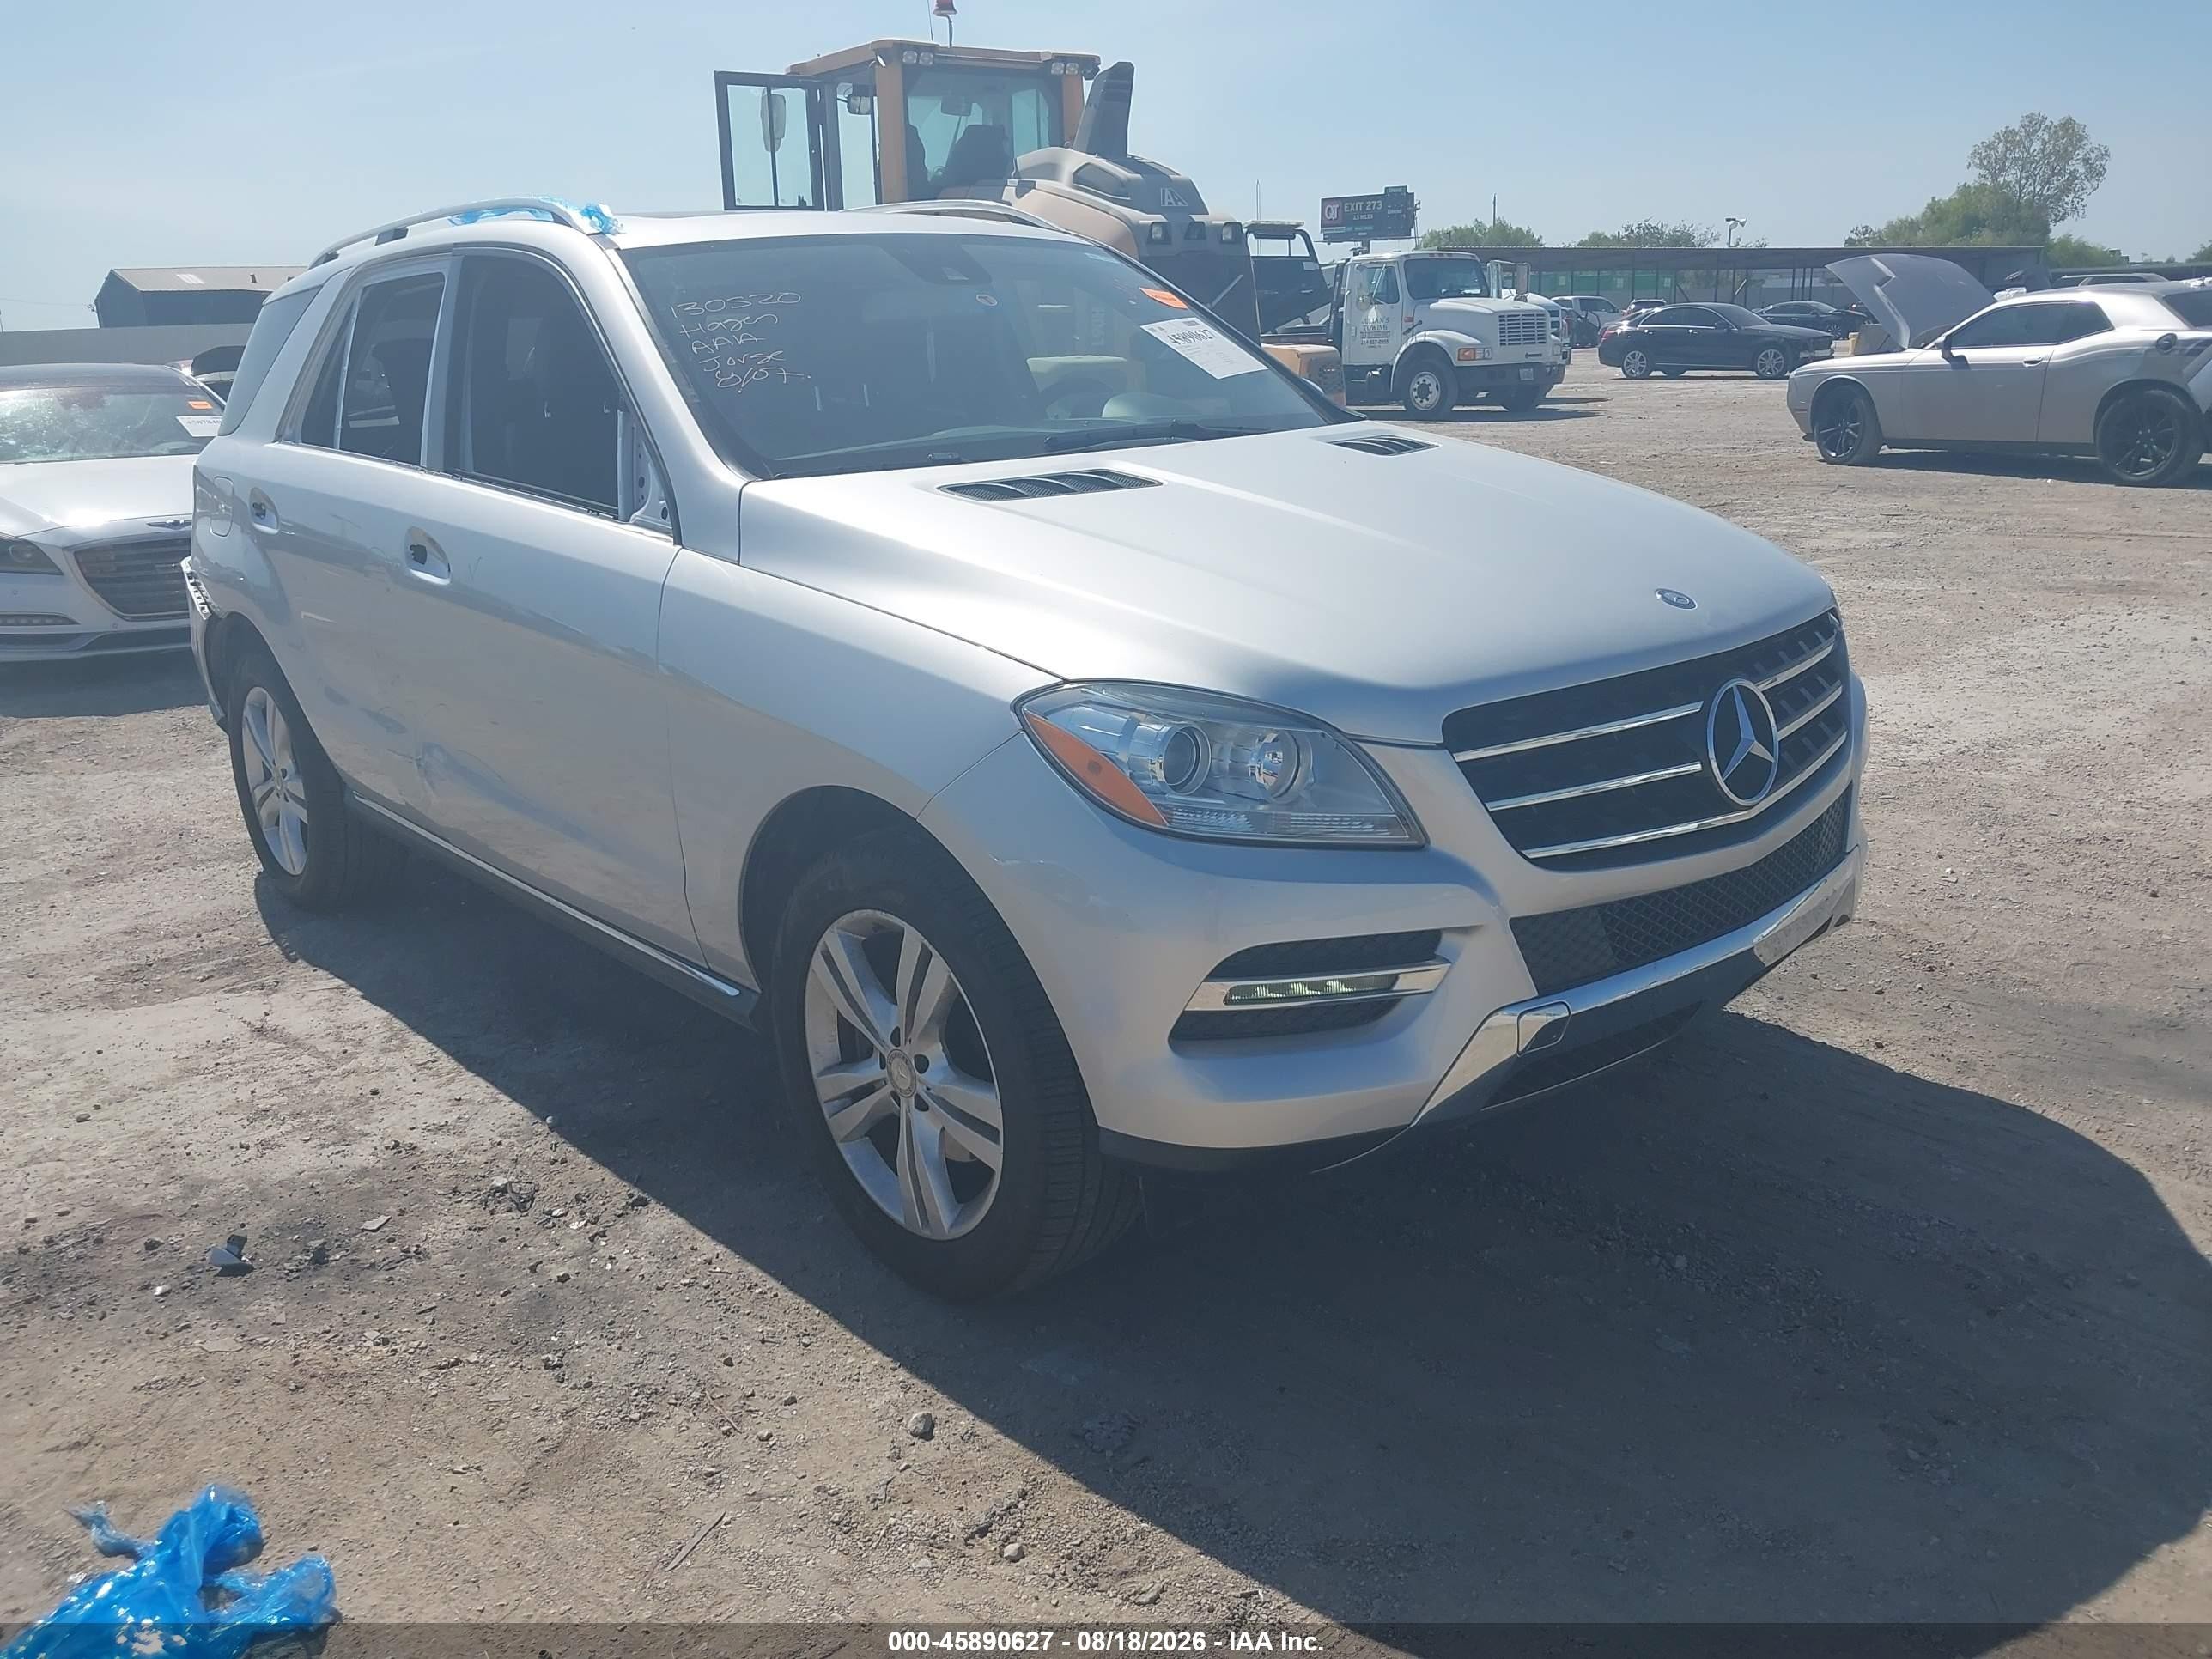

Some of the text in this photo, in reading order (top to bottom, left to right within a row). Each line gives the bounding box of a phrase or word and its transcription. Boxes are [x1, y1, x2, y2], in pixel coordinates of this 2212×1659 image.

[1325, 200, 1383, 220] QT EXIT 273
